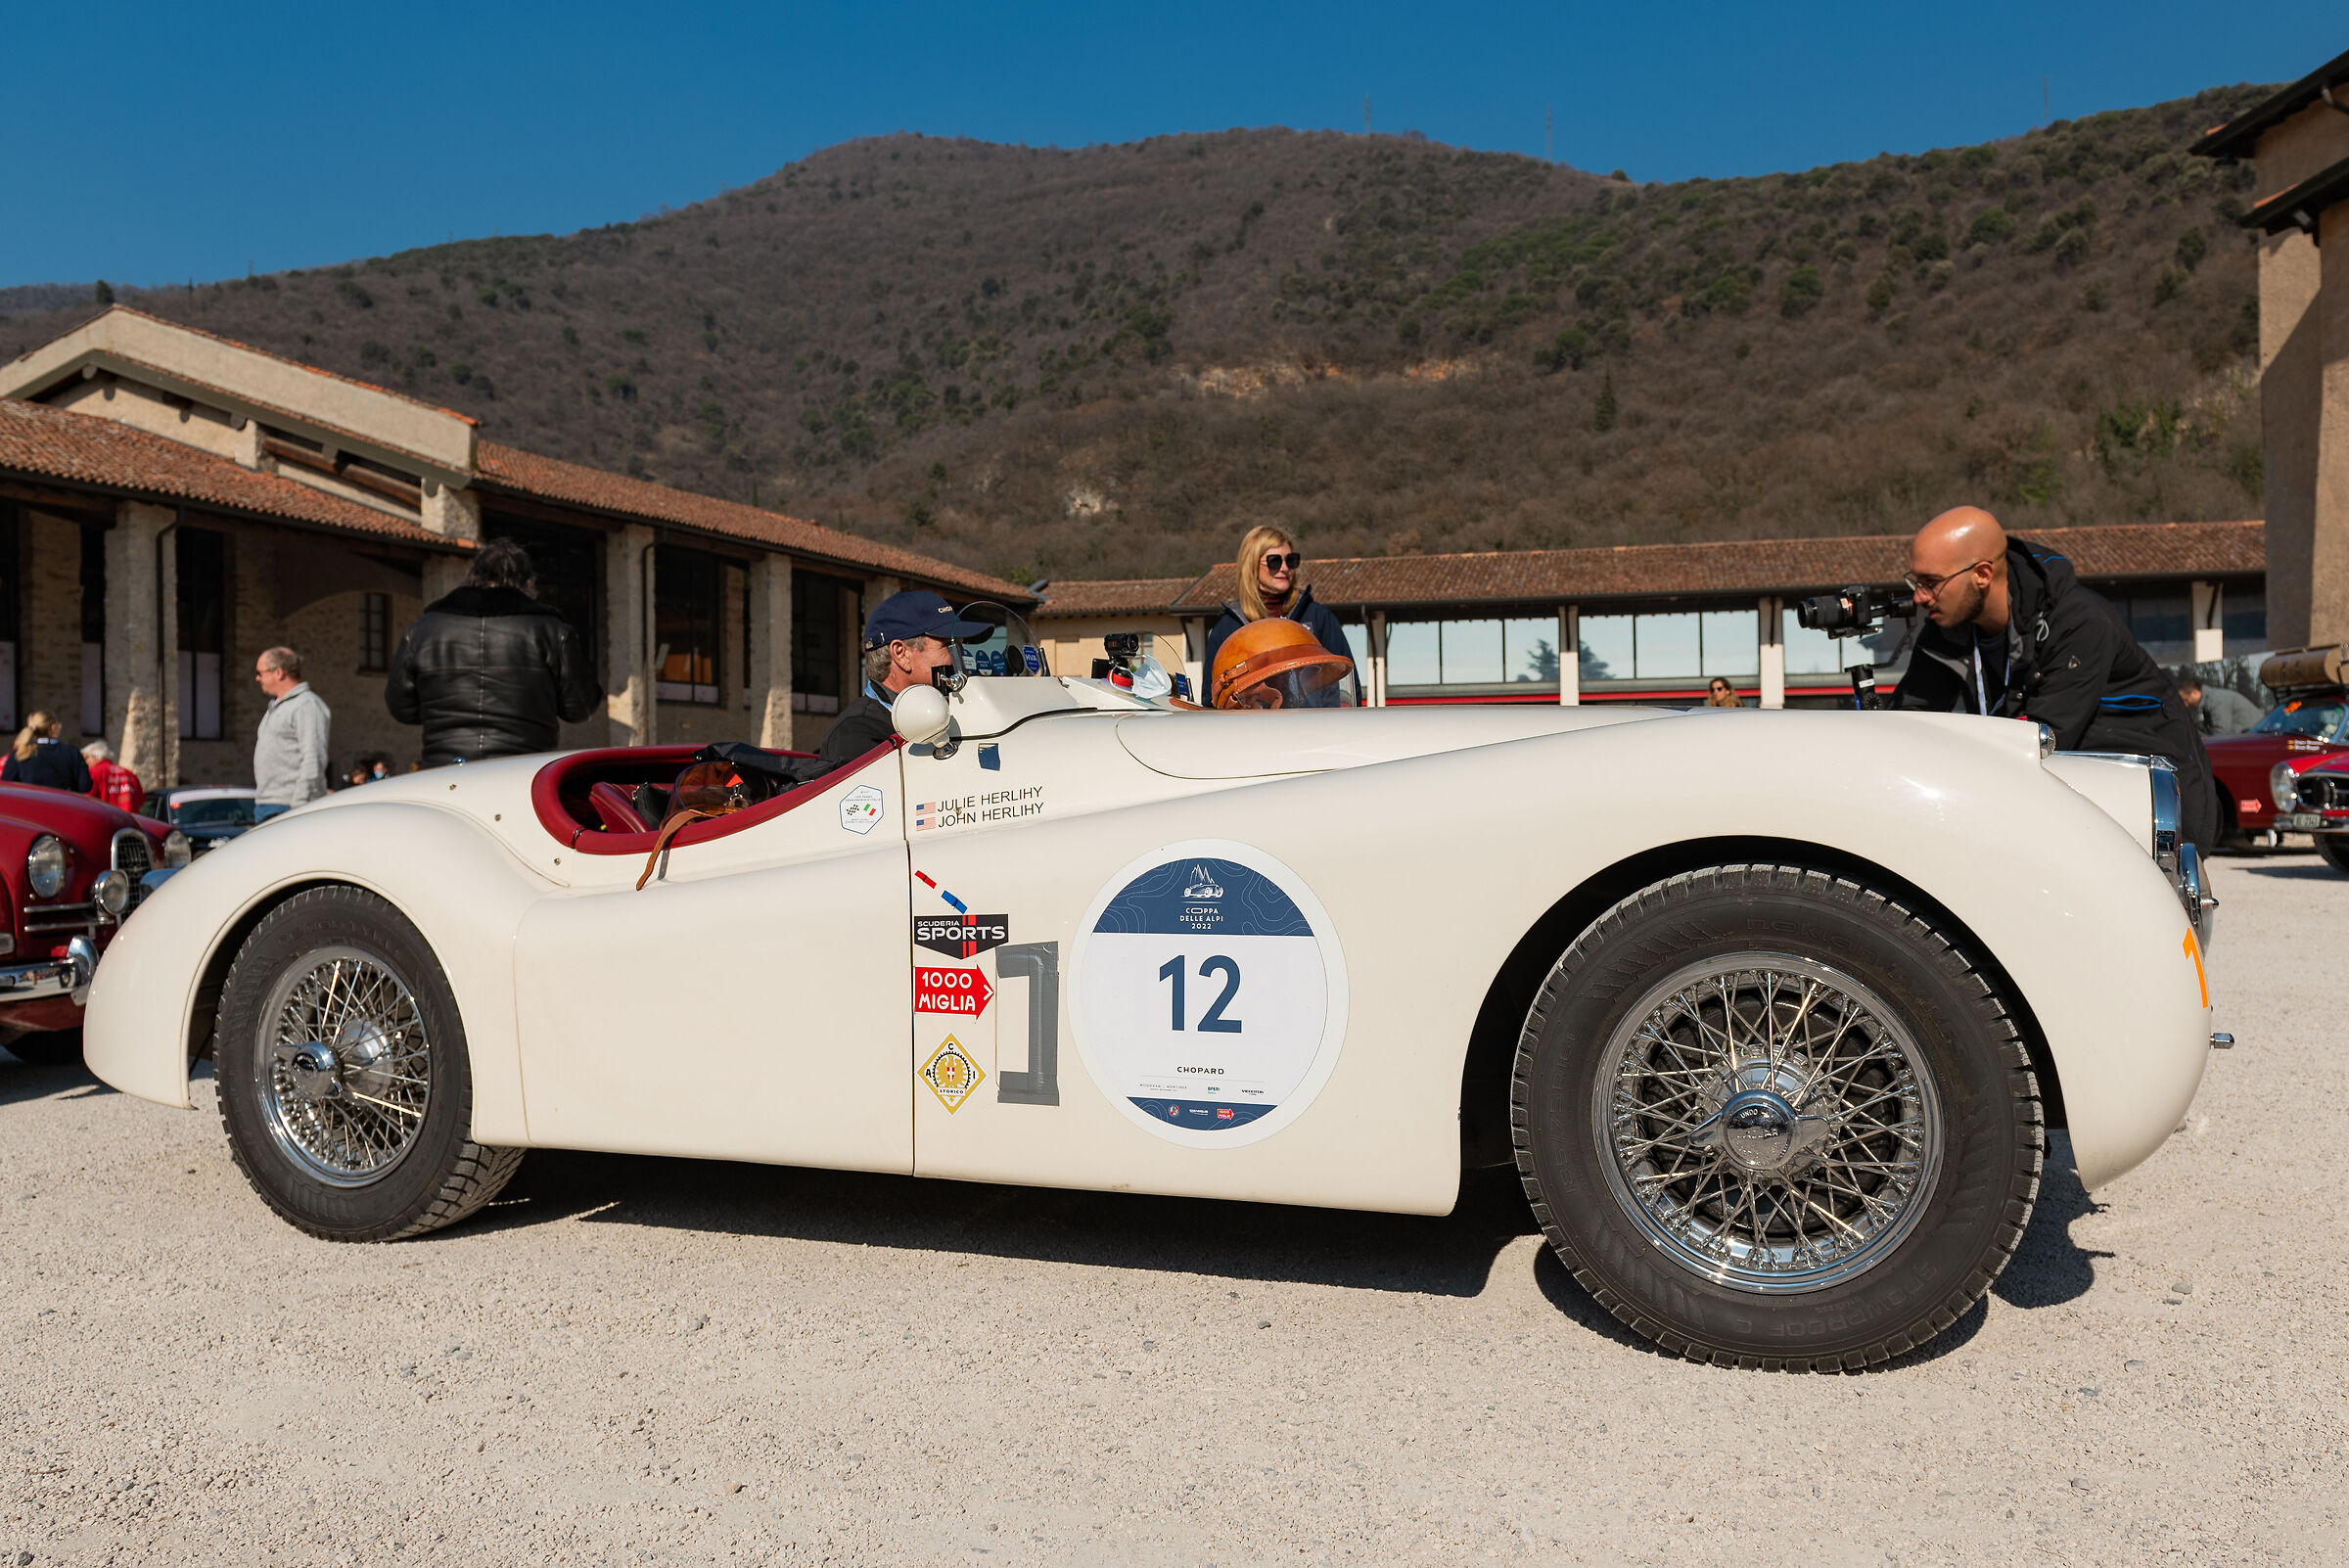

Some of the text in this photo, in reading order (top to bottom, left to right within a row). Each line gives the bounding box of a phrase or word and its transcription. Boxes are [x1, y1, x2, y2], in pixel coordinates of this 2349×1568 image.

[937, 785, 1043, 812] JULIE HERLIHY
[938, 802, 1044, 828] JOHN HERLIHY
[917, 926, 1006, 941] SPORTS
[922, 971, 972, 989] 1000
[918, 993, 976, 1012] MIGLIA
[1159, 954, 1243, 1034] 12
[1176, 1066, 1224, 1075] CHOPARD
